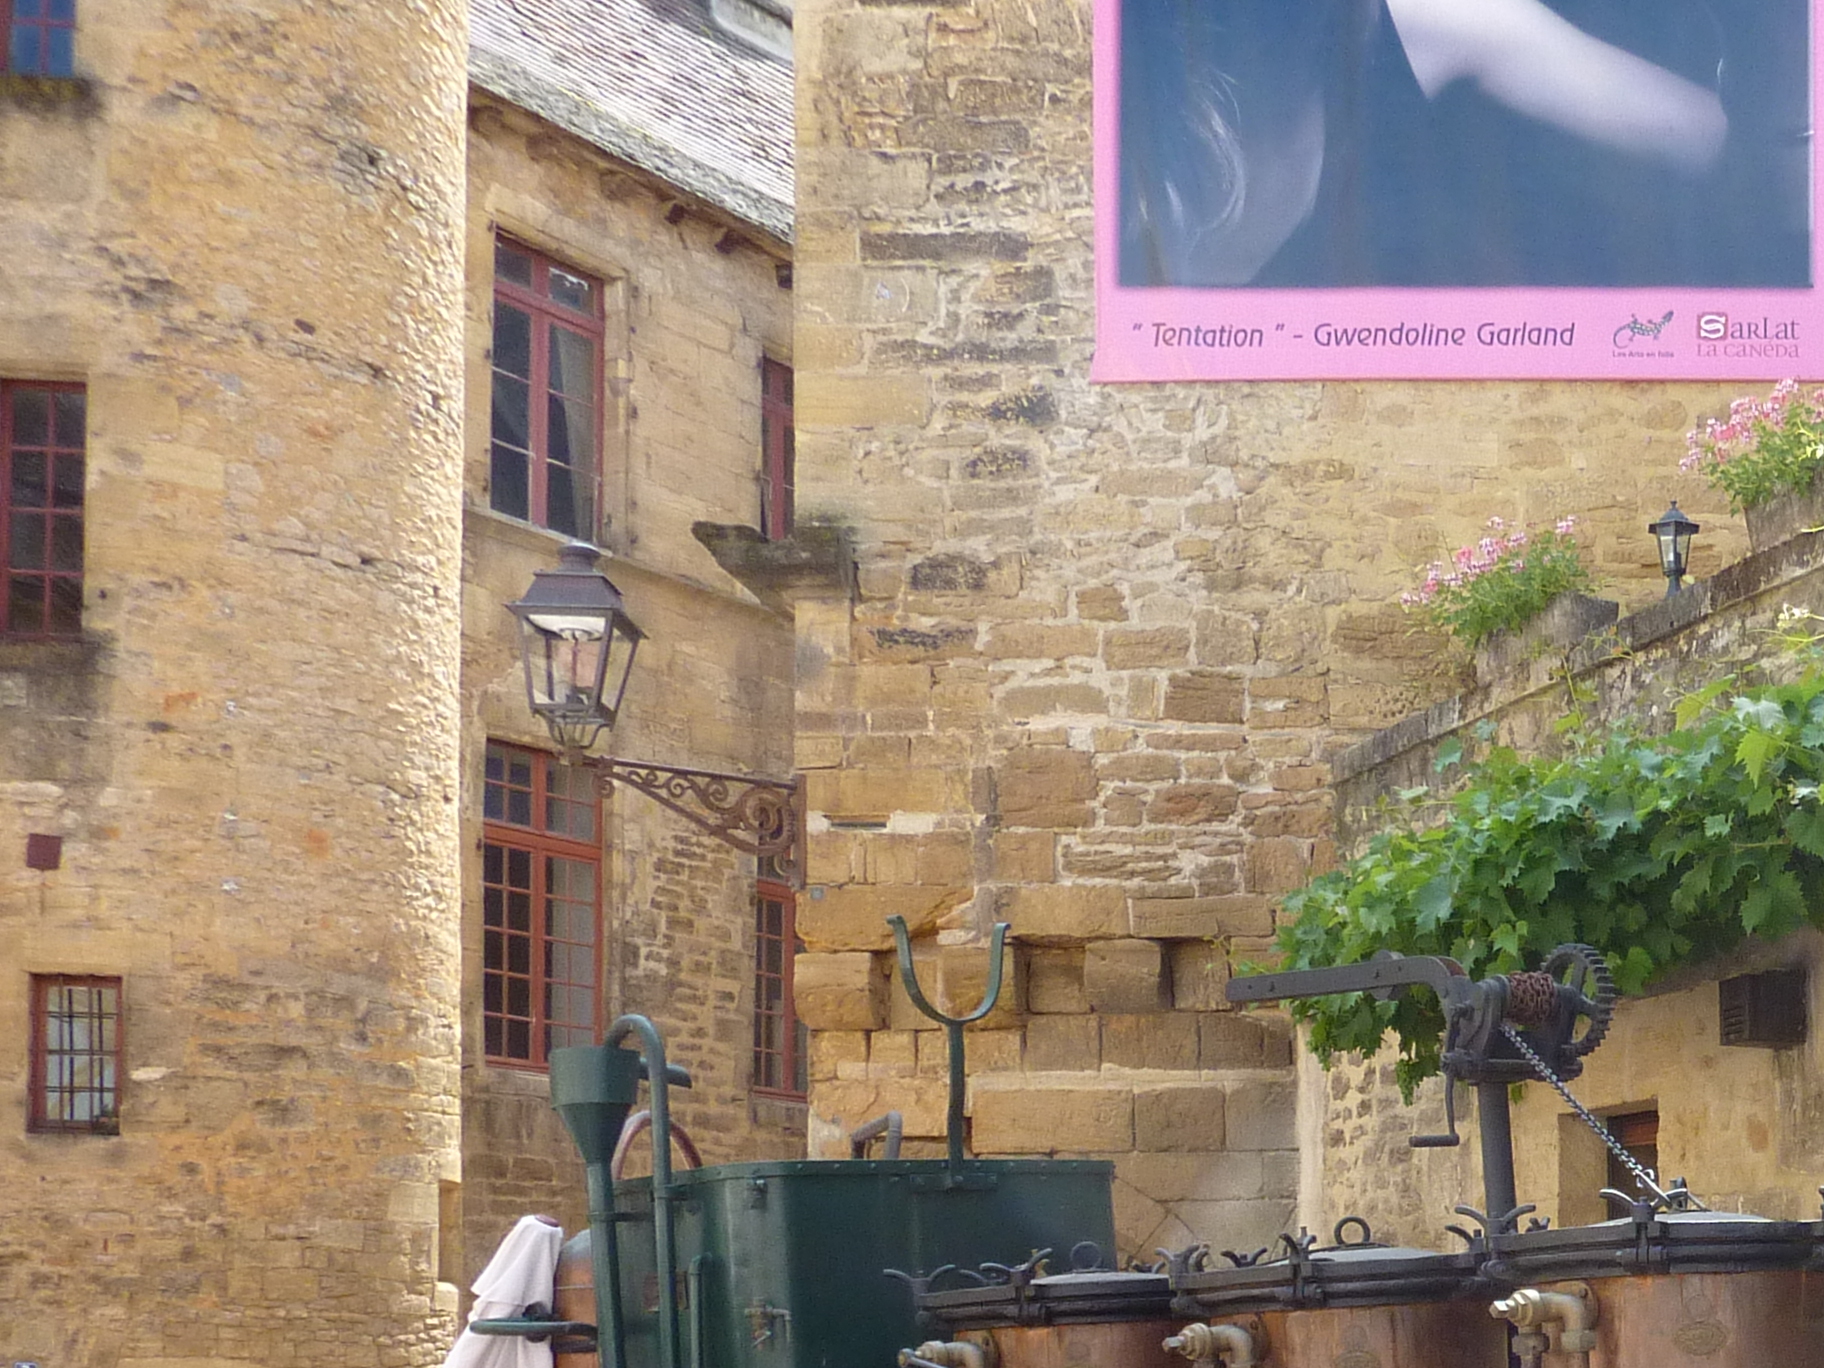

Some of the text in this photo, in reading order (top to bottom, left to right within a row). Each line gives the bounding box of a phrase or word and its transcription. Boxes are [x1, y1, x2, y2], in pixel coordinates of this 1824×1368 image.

[1152, 321, 1264, 348] Tentation
[1313, 321, 1467, 347] Gwendoline
[1476, 321, 1576, 347] Garland
